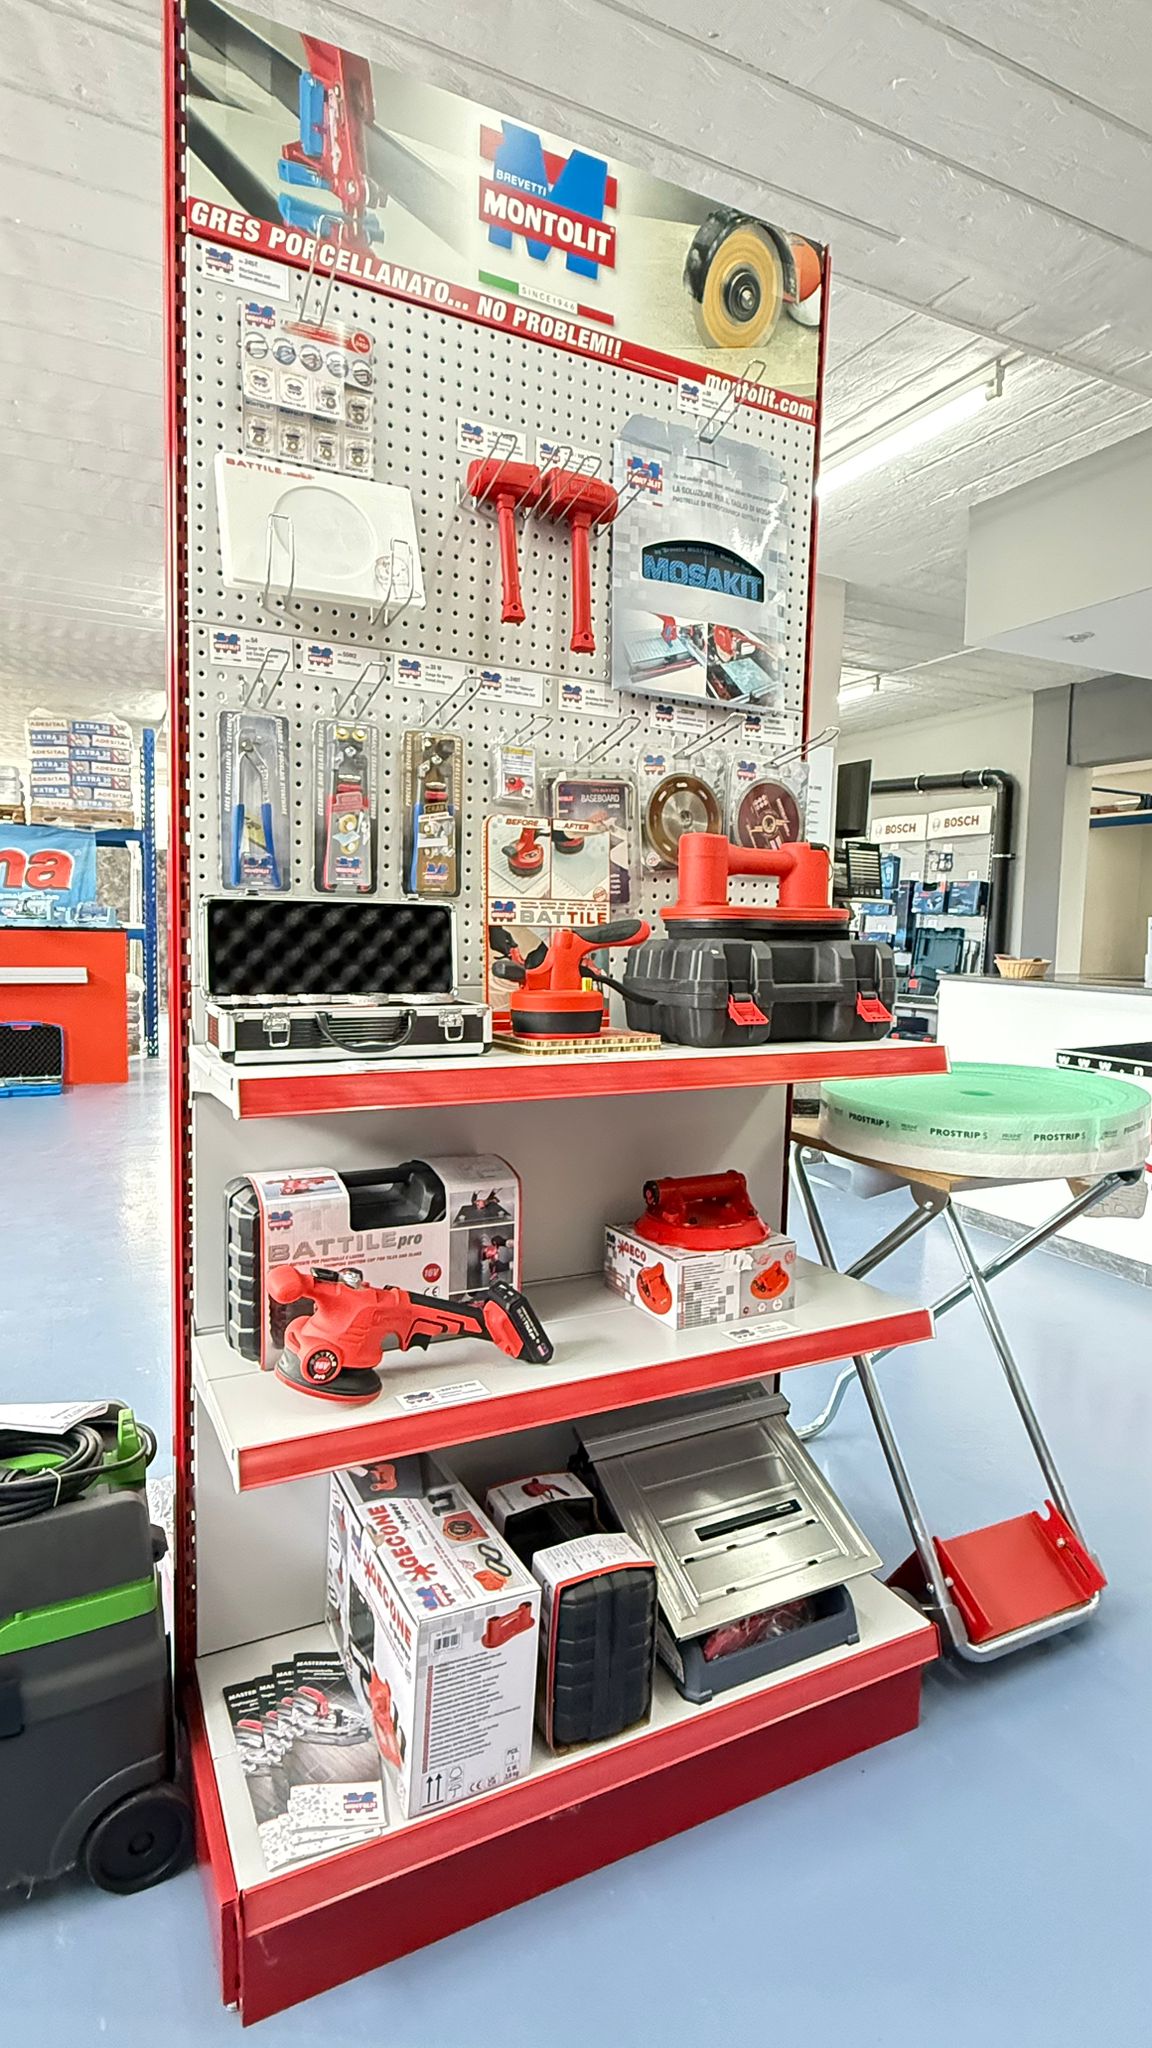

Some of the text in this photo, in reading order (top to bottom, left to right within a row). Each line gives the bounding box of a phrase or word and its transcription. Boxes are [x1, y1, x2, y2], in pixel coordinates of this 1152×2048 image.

[496, 168, 548, 197] BREVETTI
[483, 188, 612, 257] MONTOLIT
[191, 202, 260, 243] GRES
[477, 295, 507, 322] NO
[513, 308, 622, 359] PROBLEM!!
[705, 373, 814, 421] montolit.com
[226, 458, 282, 474] BATTILE
[644, 554, 762, 599] MOSAKIT
[581, 794, 620, 803] BASEBOARD
[885, 823, 917, 835] BOSCH
[944, 814, 980, 828] BOSCH
[520, 910, 607, 924] BATTILE
[849, 1112, 885, 1126] PROSTRIP
[930, 1127, 981, 1140] PROSTRIP
[1033, 1132, 1081, 1142] PROSTRIP
[268, 1231, 423, 1263] BATTILE pro
[624, 1240, 647, 1262] GECO
[367, 1504, 419, 1569] GECONE
[371, 1562, 412, 1652] GECONE
